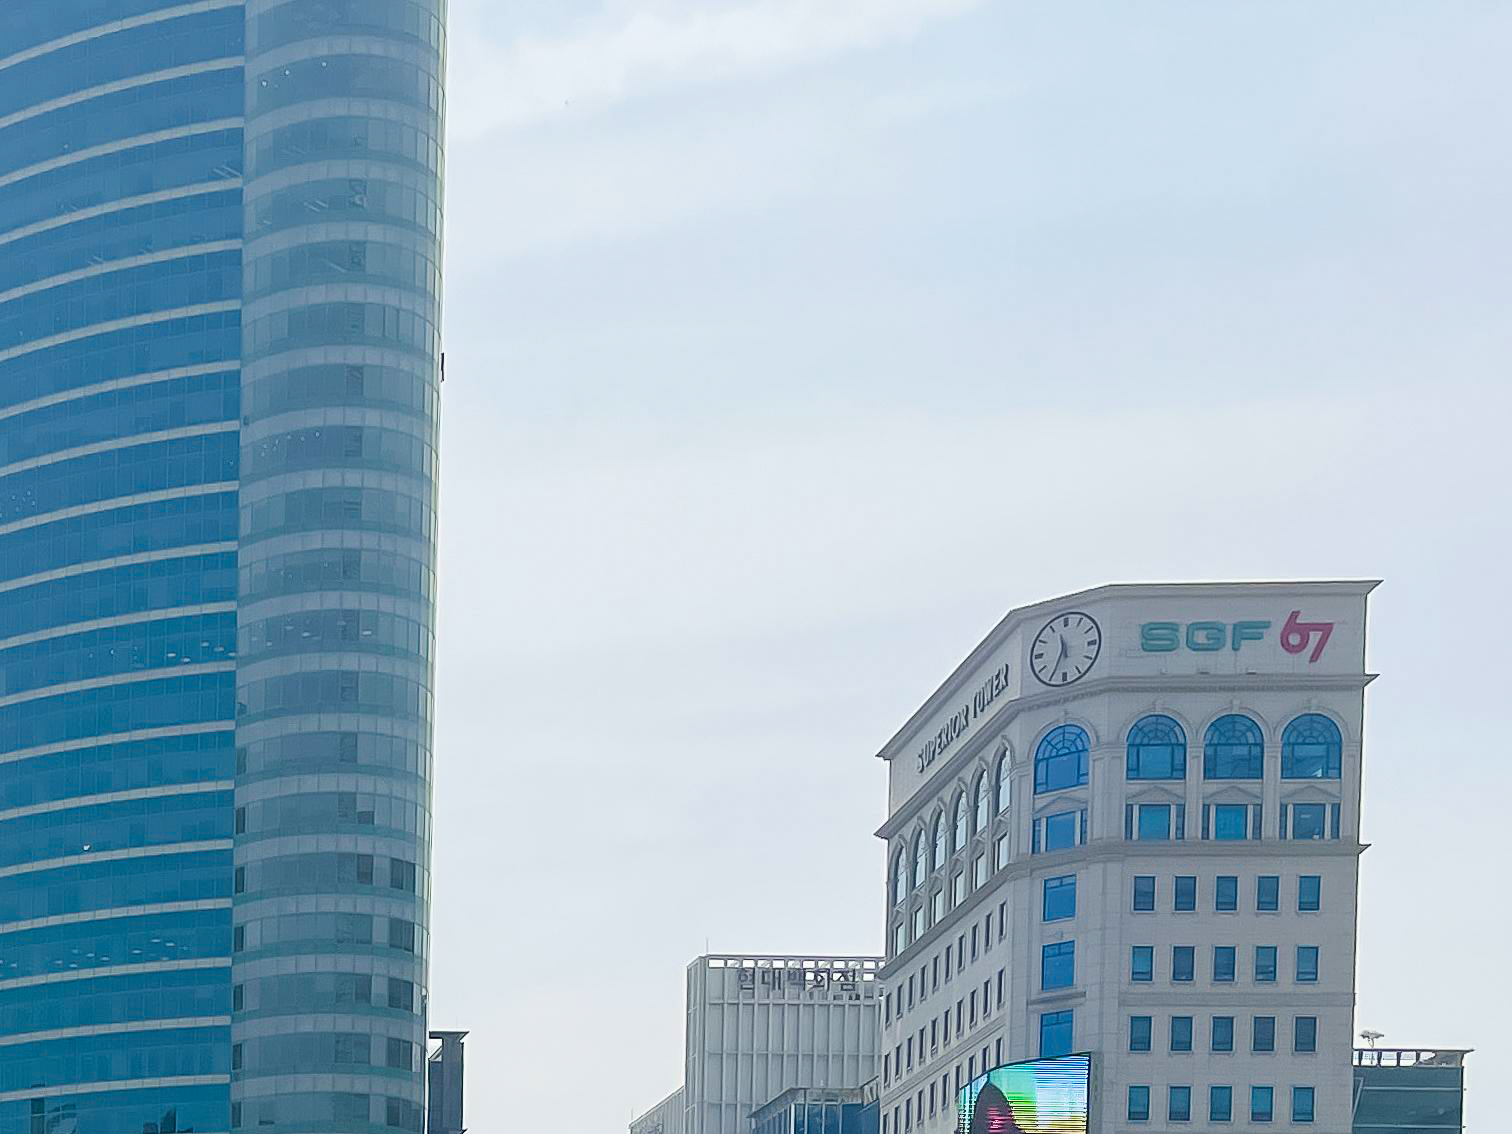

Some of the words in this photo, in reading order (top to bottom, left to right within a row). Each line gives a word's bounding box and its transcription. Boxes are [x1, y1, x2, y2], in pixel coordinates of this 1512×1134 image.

[1141, 621, 1272, 652] SGF
[918, 704, 970, 774] SUPERIOR
[973, 663, 1009, 719] TOWER
